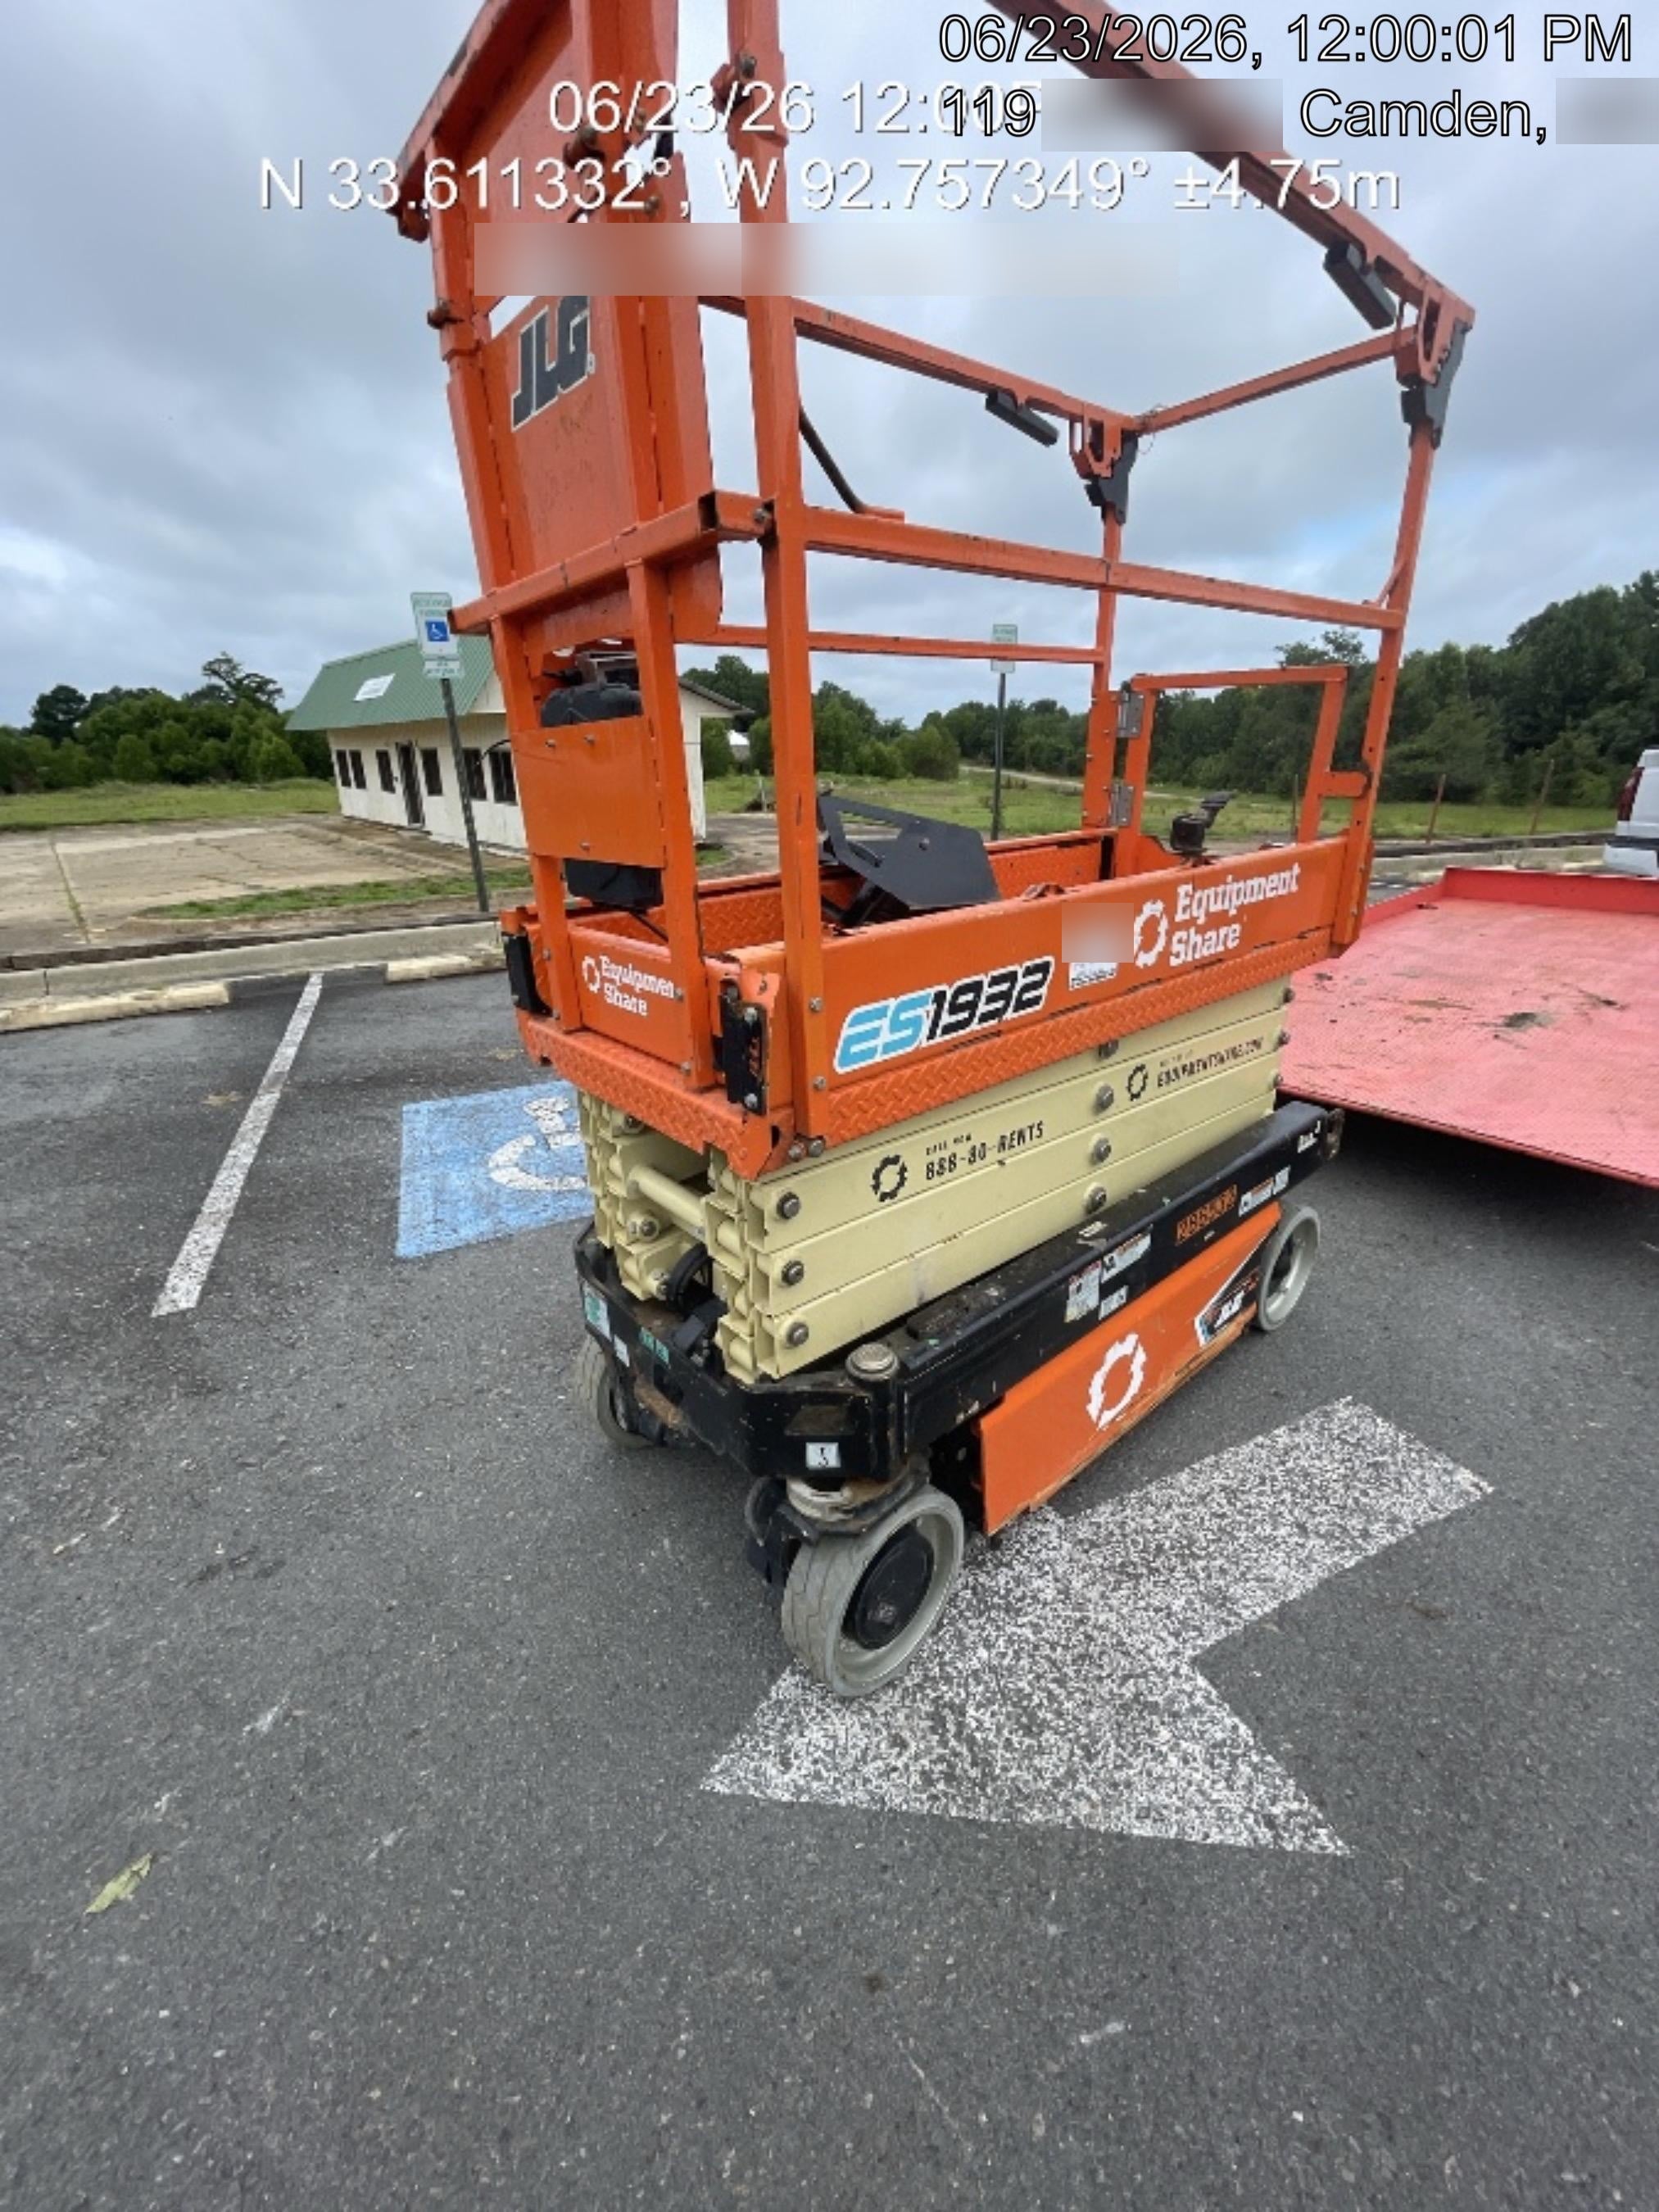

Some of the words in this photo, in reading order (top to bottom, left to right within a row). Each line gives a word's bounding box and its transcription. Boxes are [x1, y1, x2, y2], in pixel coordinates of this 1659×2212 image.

[510, 296, 590, 433] JLG
[1175, 862, 1301, 925] Equipment
[1169, 922, 1242, 967] Share
[604, 982, 648, 1017] Share
[833, 955, 1055, 1075] ES1932
